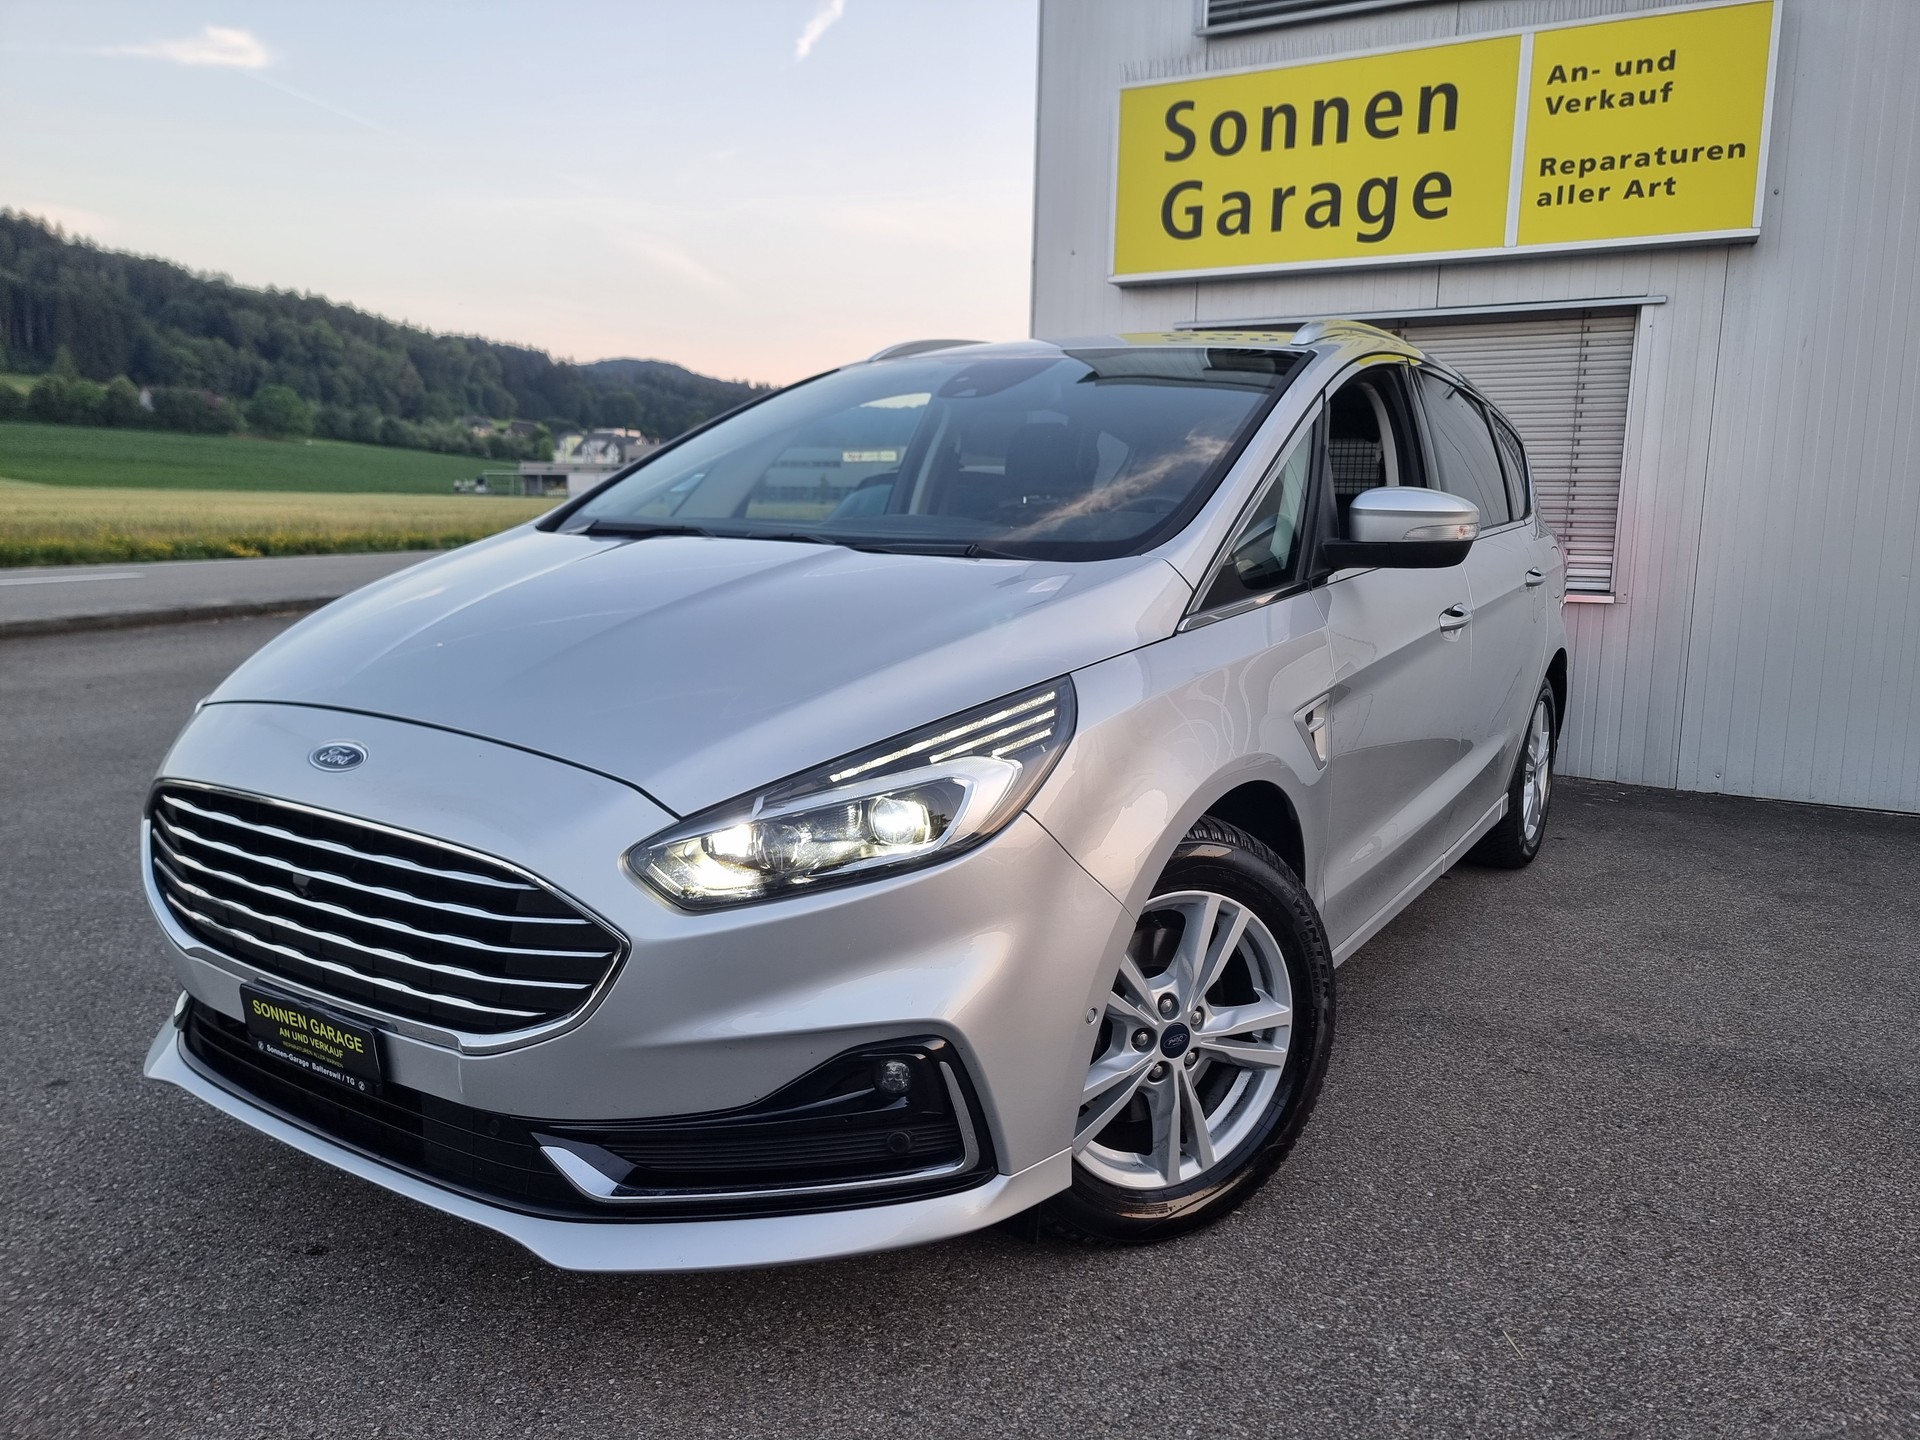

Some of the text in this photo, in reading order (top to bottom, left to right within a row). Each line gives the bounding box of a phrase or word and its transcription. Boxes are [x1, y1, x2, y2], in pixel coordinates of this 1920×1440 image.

[1546, 49, 1677, 86] An- und
[1545, 81, 1674, 116] Verkauf
[1164, 82, 1459, 163] Sonnen
[1539, 142, 1747, 178] Reparaturen
[1160, 171, 1452, 243] Garage
[1536, 176, 1677, 208] aller Art
[1293, 897, 1331, 999] WINTER
[252, 999, 364, 1053] SONNEN GARAGE
[279, 1027, 344, 1059] AN UND VERKAUF
[266, 1044, 310, 1067] Sonnen-Garage
[346, 1075, 356, 1086] TG
